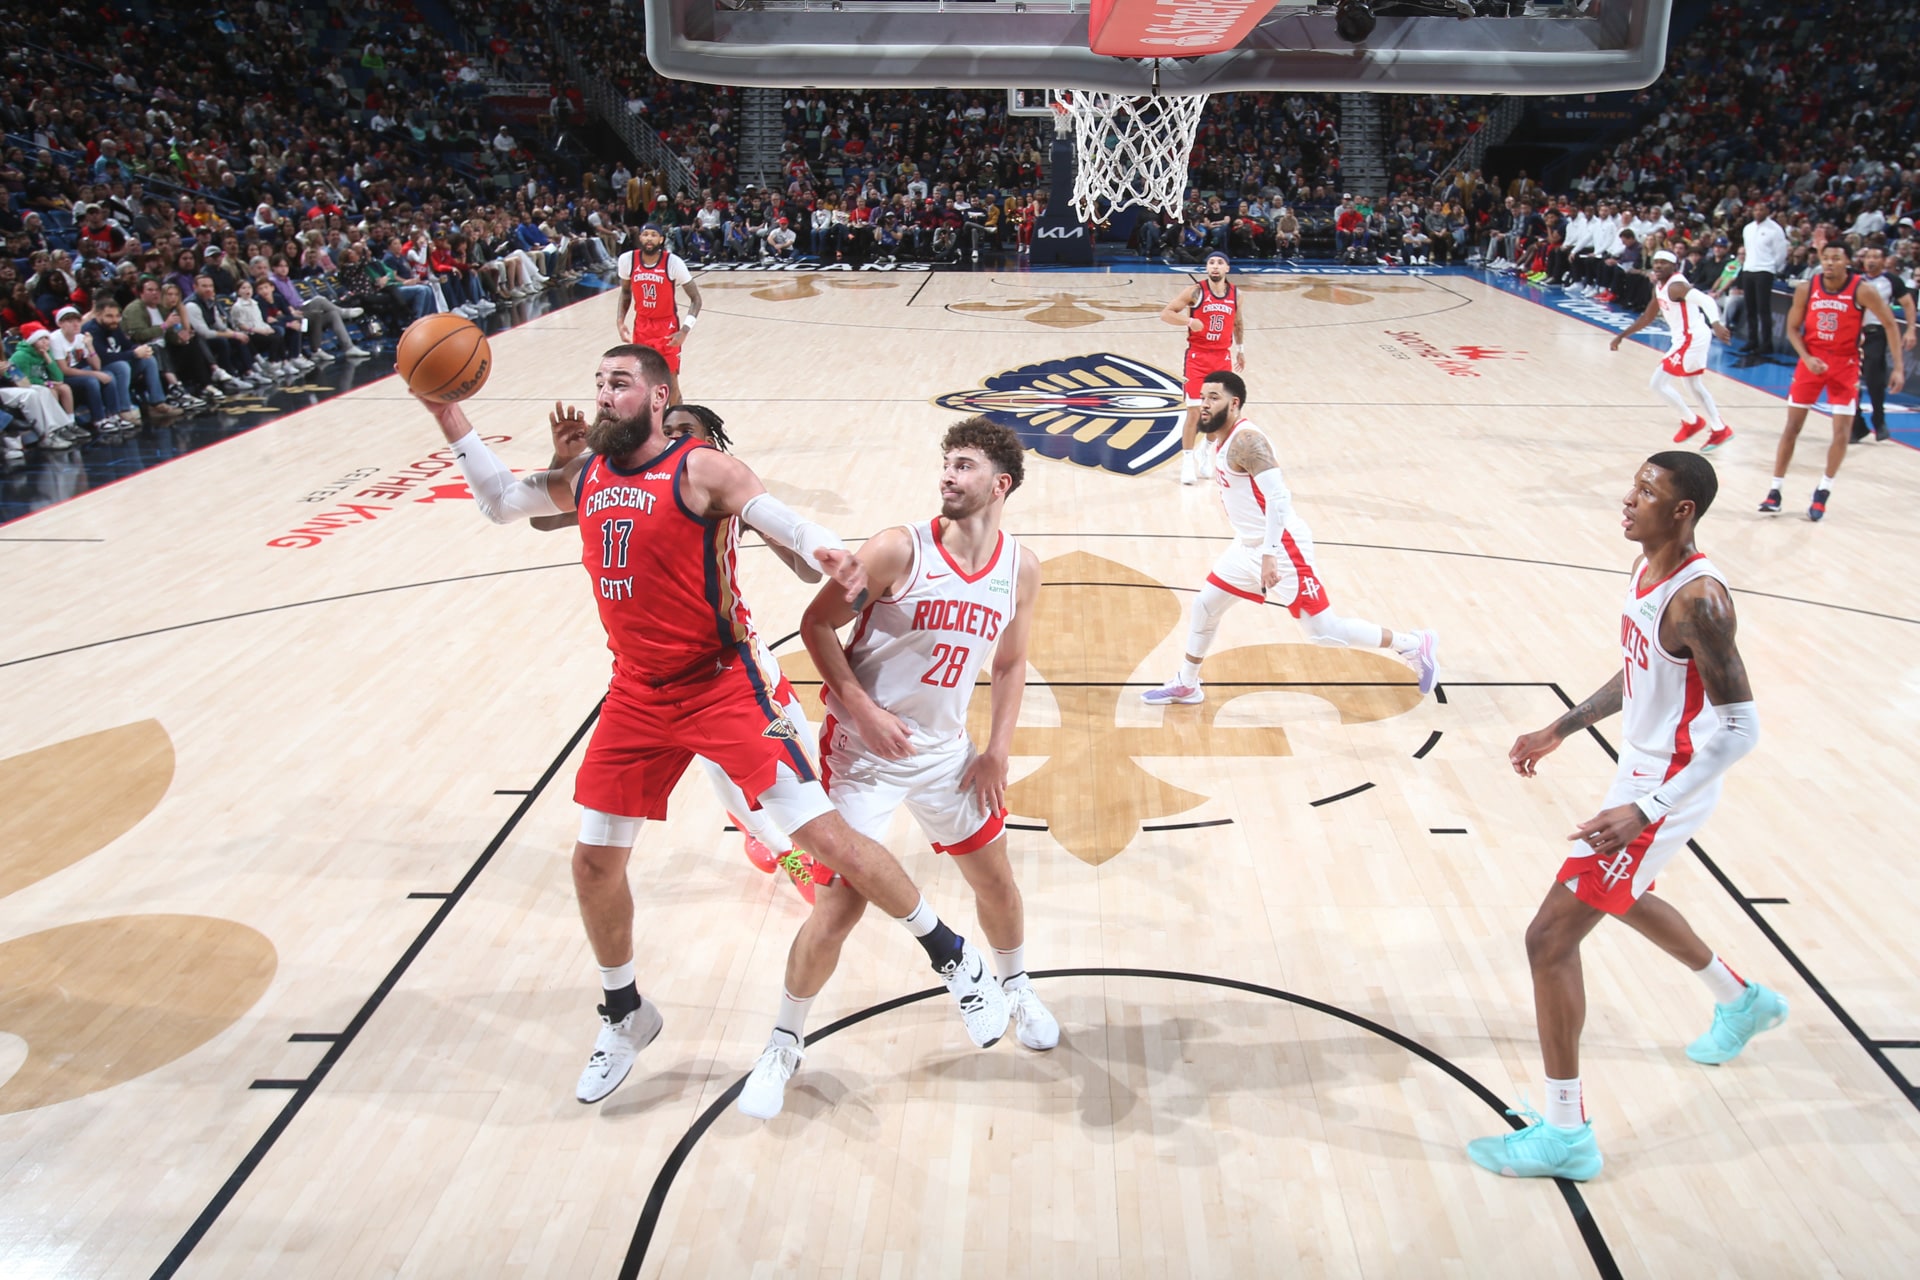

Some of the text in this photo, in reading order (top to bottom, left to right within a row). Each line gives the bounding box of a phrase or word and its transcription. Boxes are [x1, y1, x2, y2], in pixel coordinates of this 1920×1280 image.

[641, 283, 657, 300] 14
[642, 300, 657, 308] CITY
[1209, 314, 1225, 332] 15
[1816, 312, 1838, 331] 25
[1206, 332, 1221, 341] CITY
[644, 472, 671, 480] ibotta
[585, 486, 656, 517] CRESCENT
[601, 518, 634, 568] 17
[600, 575, 634, 601] CITY
[989, 586, 1009, 594] karma
[990, 578, 1009, 587] credit
[911, 599, 1002, 642] ROCKETS
[920, 643, 970, 688] 28
